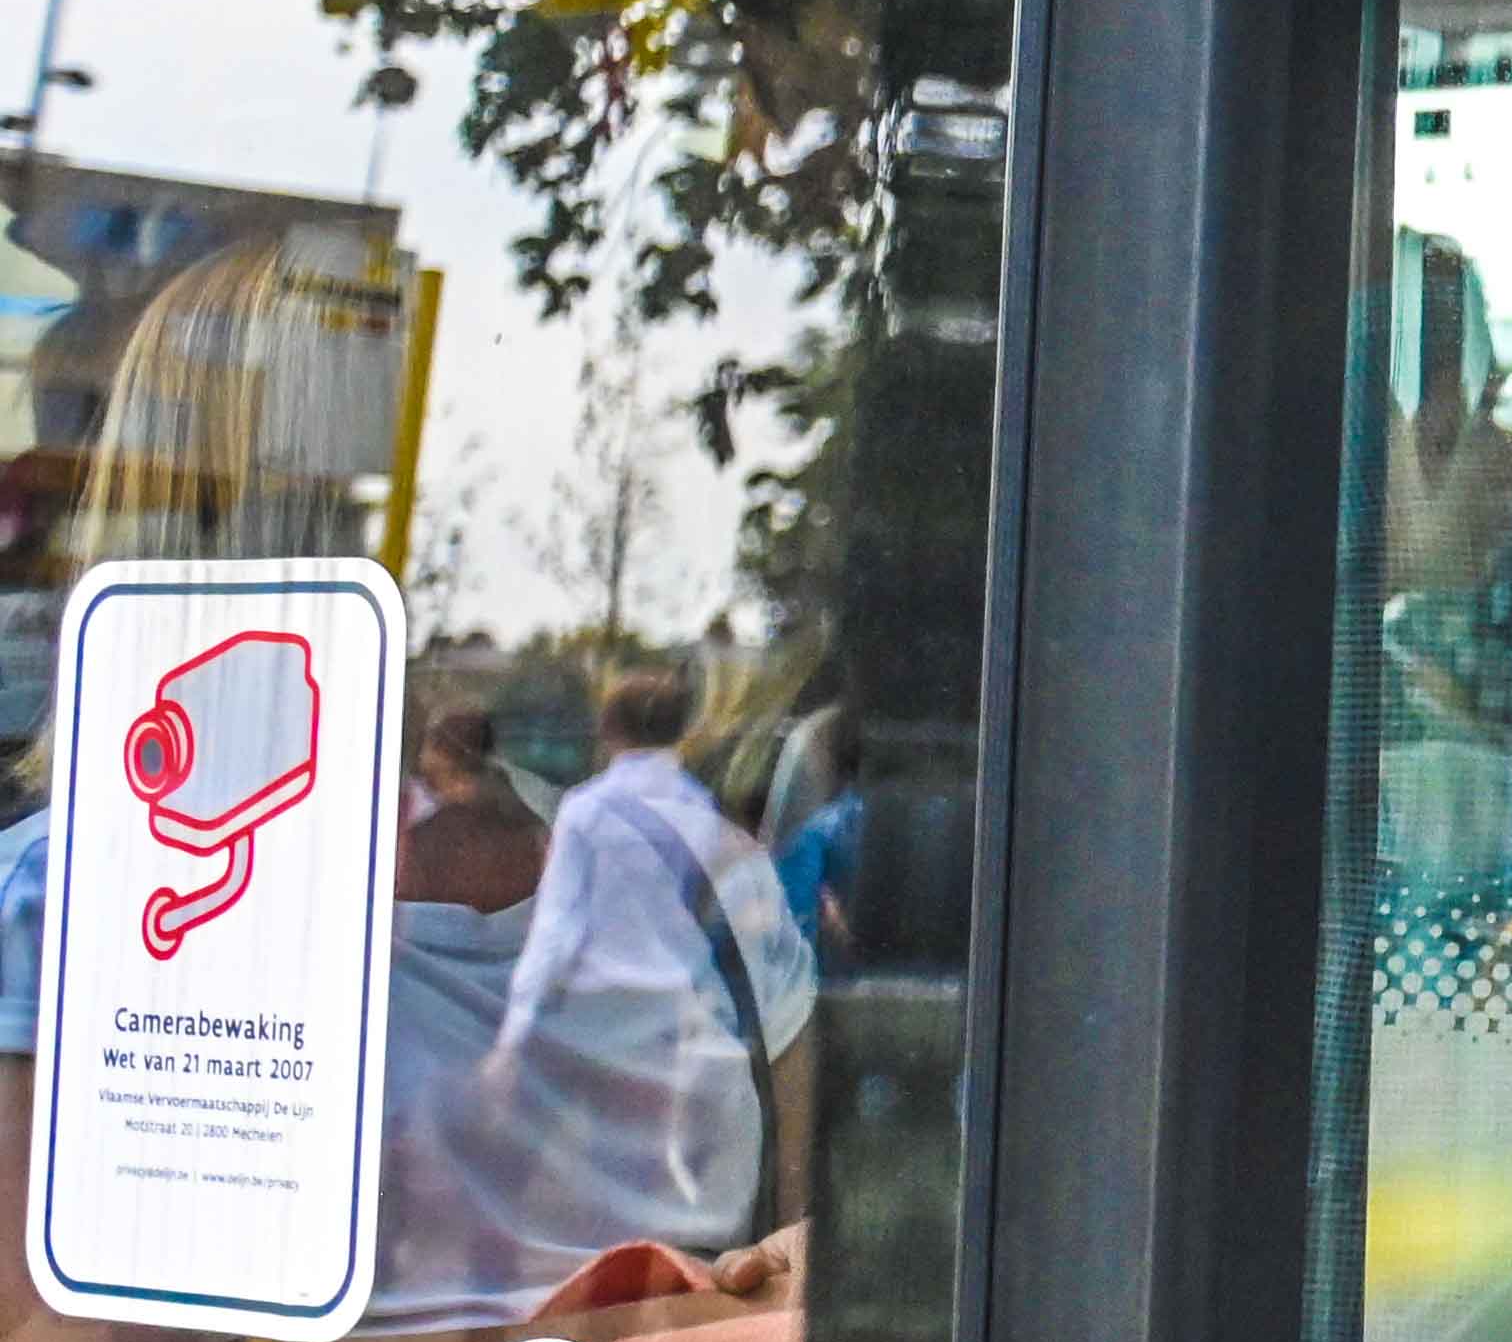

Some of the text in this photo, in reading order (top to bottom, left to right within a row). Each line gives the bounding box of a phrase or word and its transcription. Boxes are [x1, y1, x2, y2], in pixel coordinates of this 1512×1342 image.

[114, 1007, 305, 1050] Camerabewaking
[103, 1047, 314, 1081] Wet van 21 maart 2007
[98, 1089, 315, 1120] Vlaamse Vervoermaatschappij De Lijn
[202, 1124, 229, 1139] 2800
[232, 1126, 283, 1143] Mechelen
